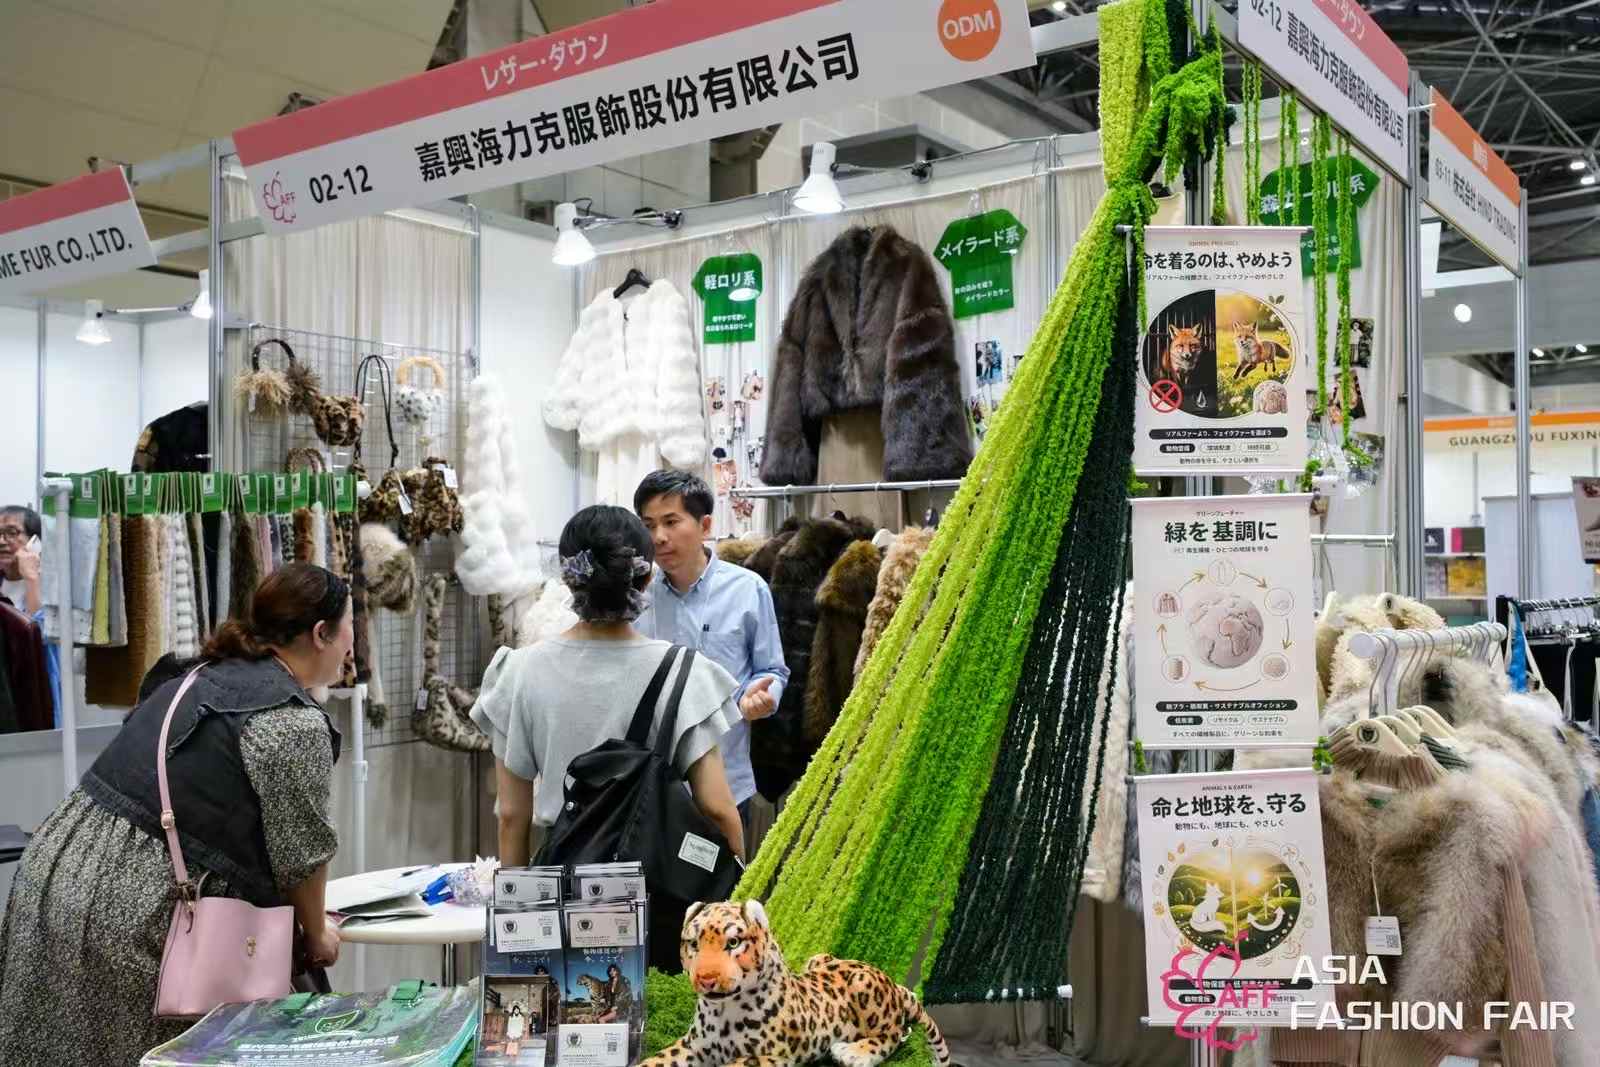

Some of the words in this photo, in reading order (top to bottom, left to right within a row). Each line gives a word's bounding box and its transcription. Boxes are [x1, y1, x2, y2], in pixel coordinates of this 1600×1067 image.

[943, 10, 995, 41] ODM
[480, 33, 608, 91] レザー・ダウン
[415, 32, 861, 182] 嘉興海力克服飾股份有限公司
[309, 164, 374, 204] 02-12
[20, 245, 57, 273] FUR
[56, 227, 133, 264] CO.,LTD.
[940, 225, 1020, 260] メイラード系
[704, 269, 756, 291] 軽ロリ系
[1449, 433, 1545, 447] GUANGZU
[1551, 430, 1600, 442] FUXIN
[1151, 793, 1307, 819] 命と地球を、守る
